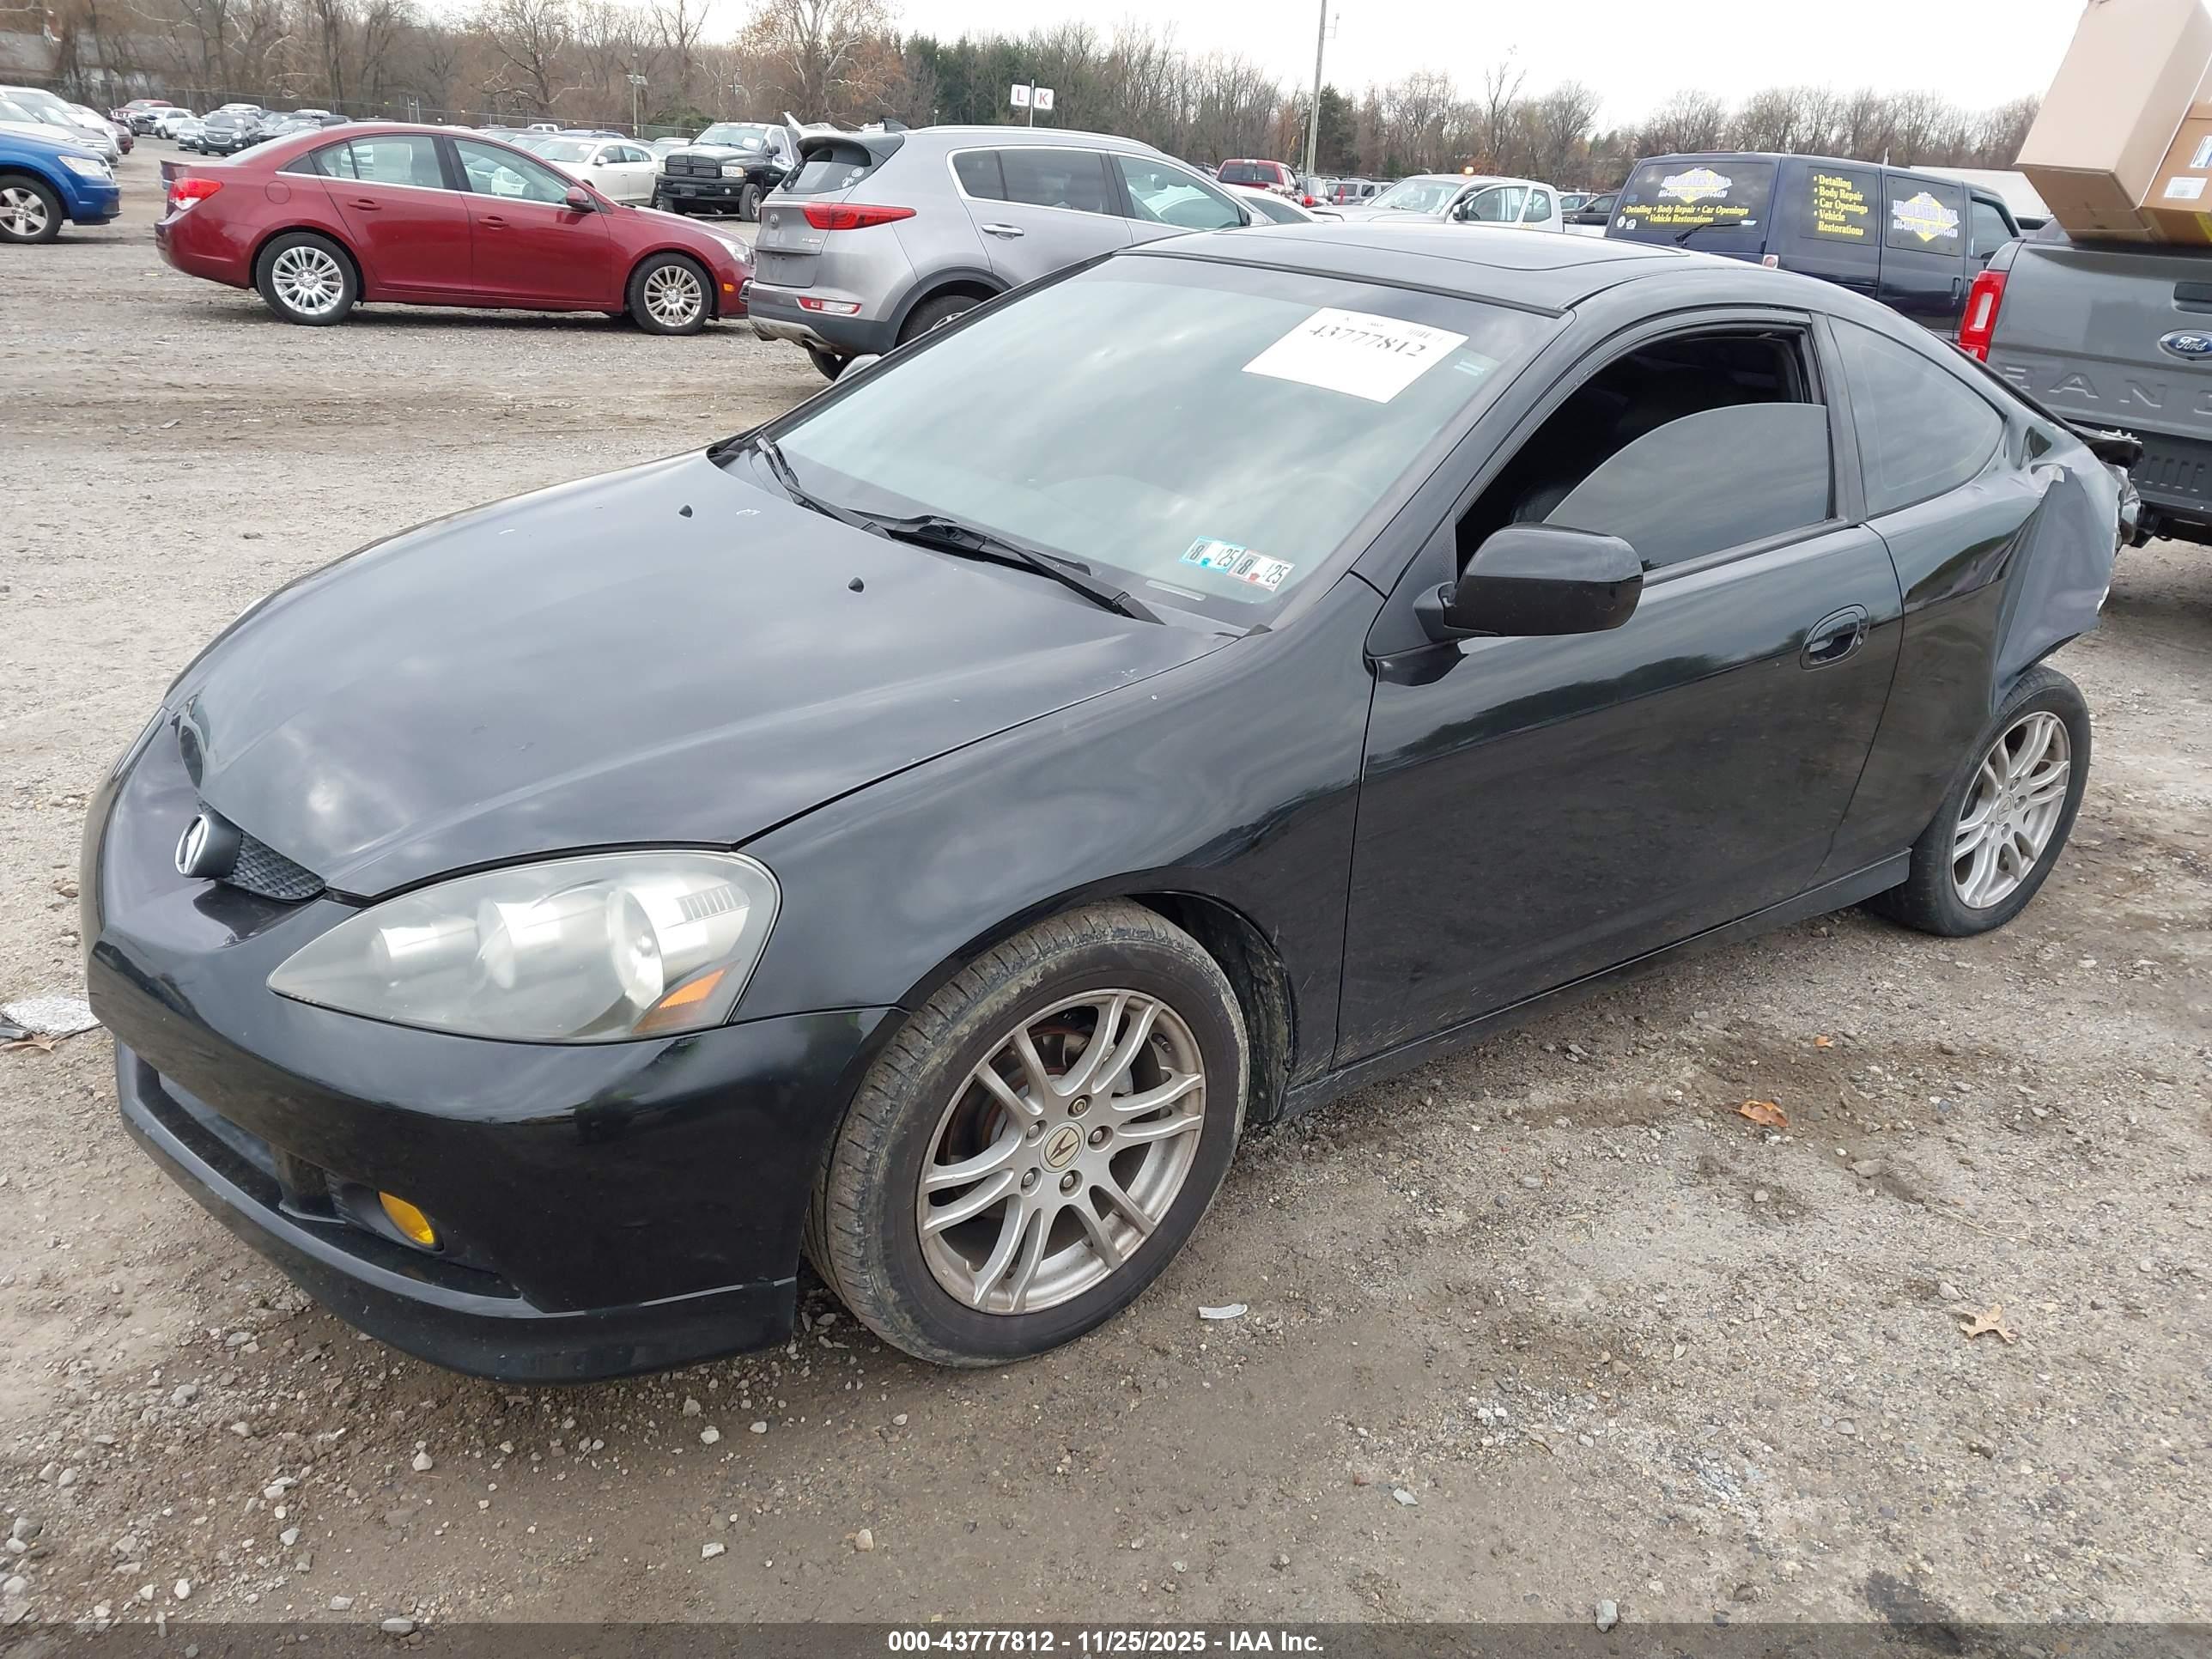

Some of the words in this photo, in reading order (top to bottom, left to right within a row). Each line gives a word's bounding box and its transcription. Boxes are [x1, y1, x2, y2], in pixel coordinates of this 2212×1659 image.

[1017, 88, 1024, 102] L
[1038, 92, 1048, 106] K
[1819, 174, 1852, 190] Detailing
[1820, 186, 1838, 199] Body
[1839, 189, 1863, 202] Repair
[1626, 205, 1652, 214] Detailing
[1656, 205, 1674, 214] Body
[1674, 205, 1696, 215] Repair
[1701, 205, 1714, 214] Car
[1716, 205, 1749, 216] Openings
[1820, 198, 1833, 209] Car
[1834, 199, 1869, 215] Openings
[1820, 209, 1846, 222] Vehicle
[1818, 221, 1863, 236] Restorations
[1310, 325, 1426, 356] 43777812
[2176, 336, 2208, 350] Ford
[1189, 544, 1205, 561] 8
[1237, 558, 1254, 575] 8
